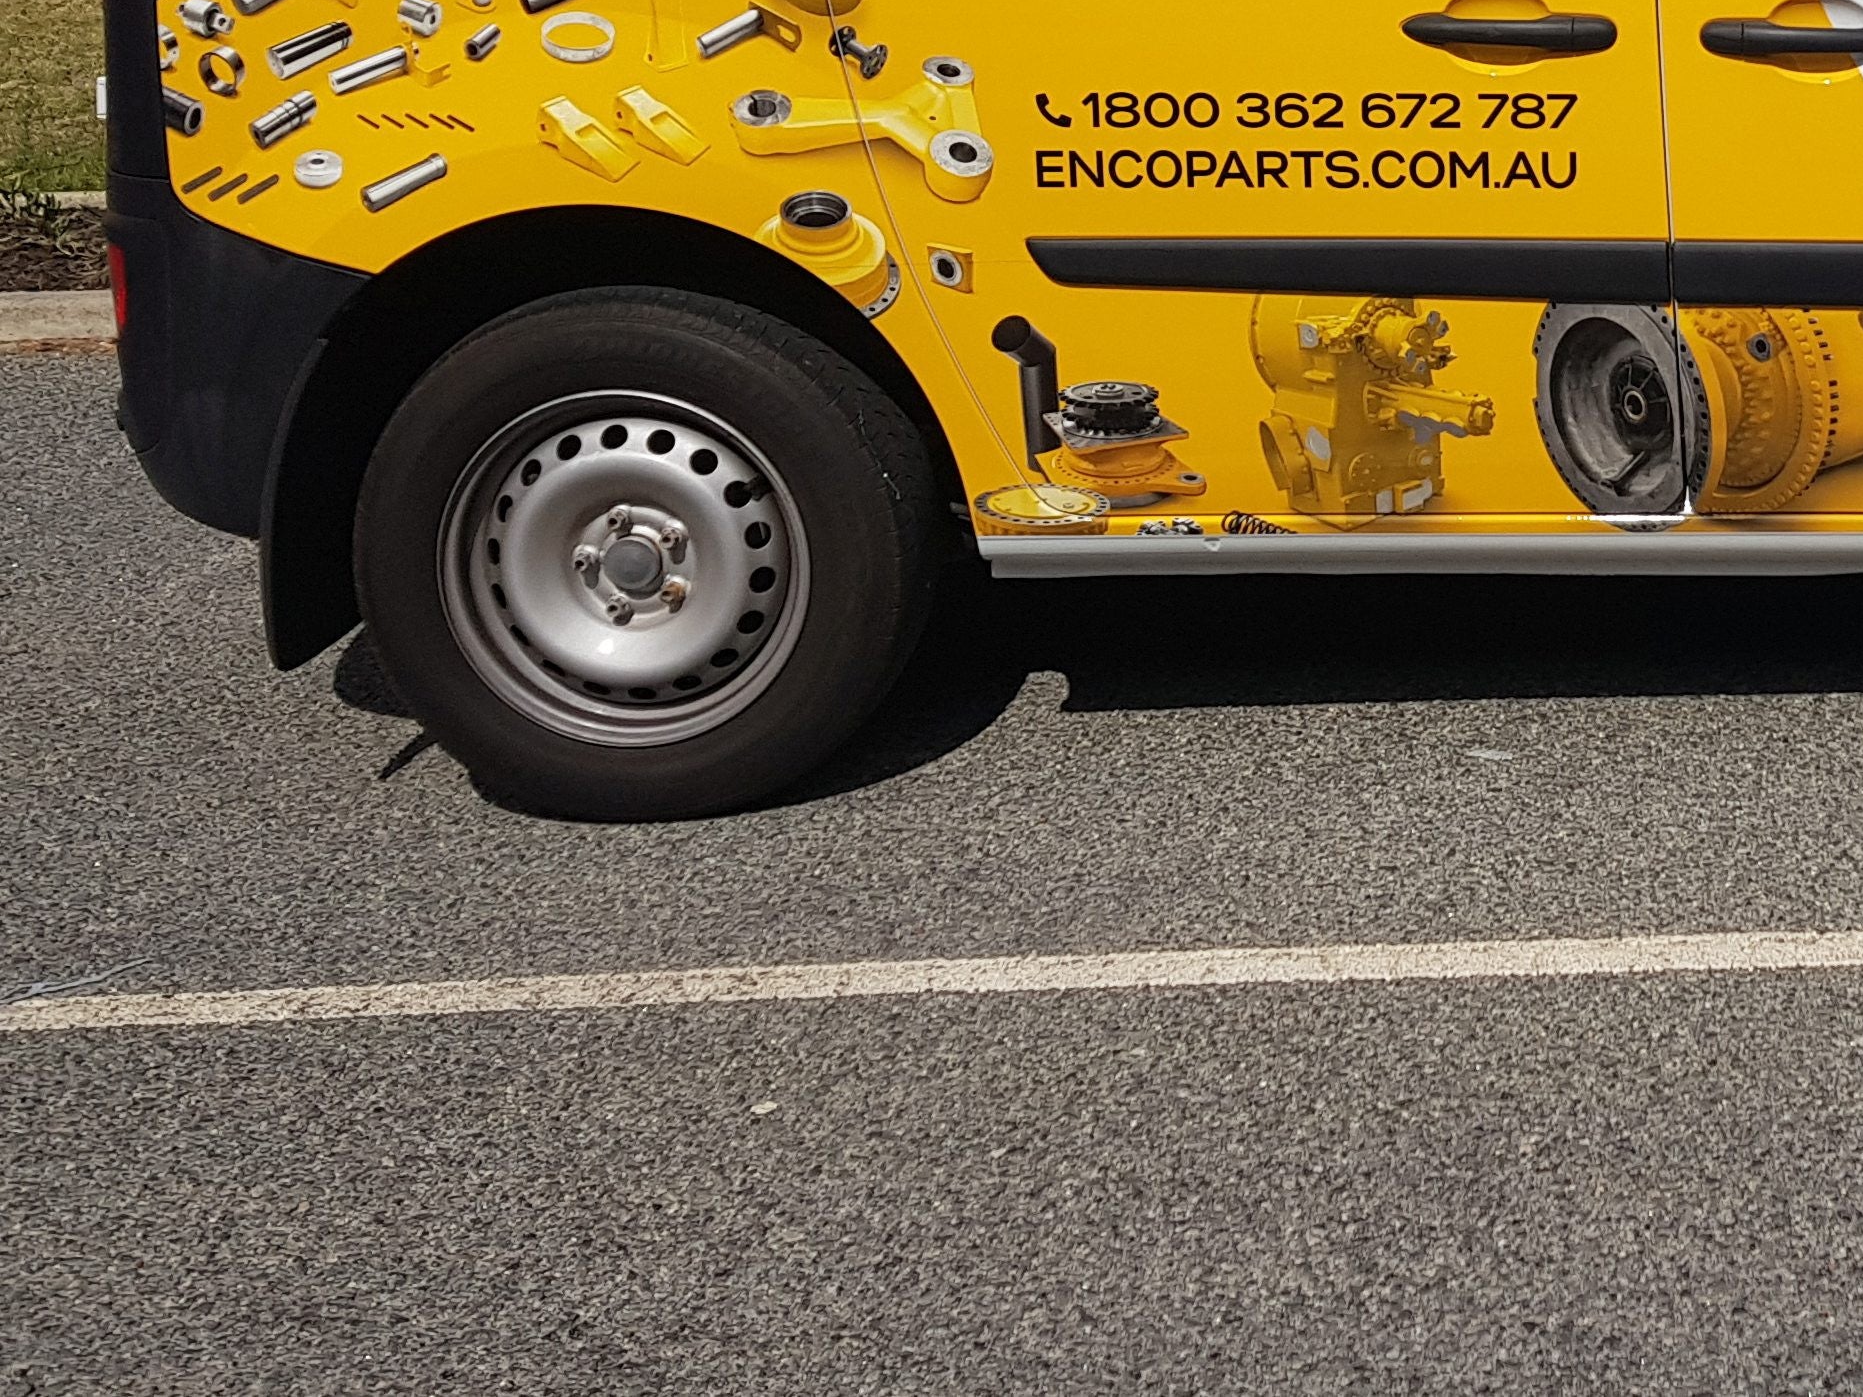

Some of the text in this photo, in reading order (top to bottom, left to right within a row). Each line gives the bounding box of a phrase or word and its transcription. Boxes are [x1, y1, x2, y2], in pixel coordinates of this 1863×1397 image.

[1082, 91, 1579, 131] 1800 362 672 787
[1035, 149, 1579, 190] ENCOPARTS.COM.AU
